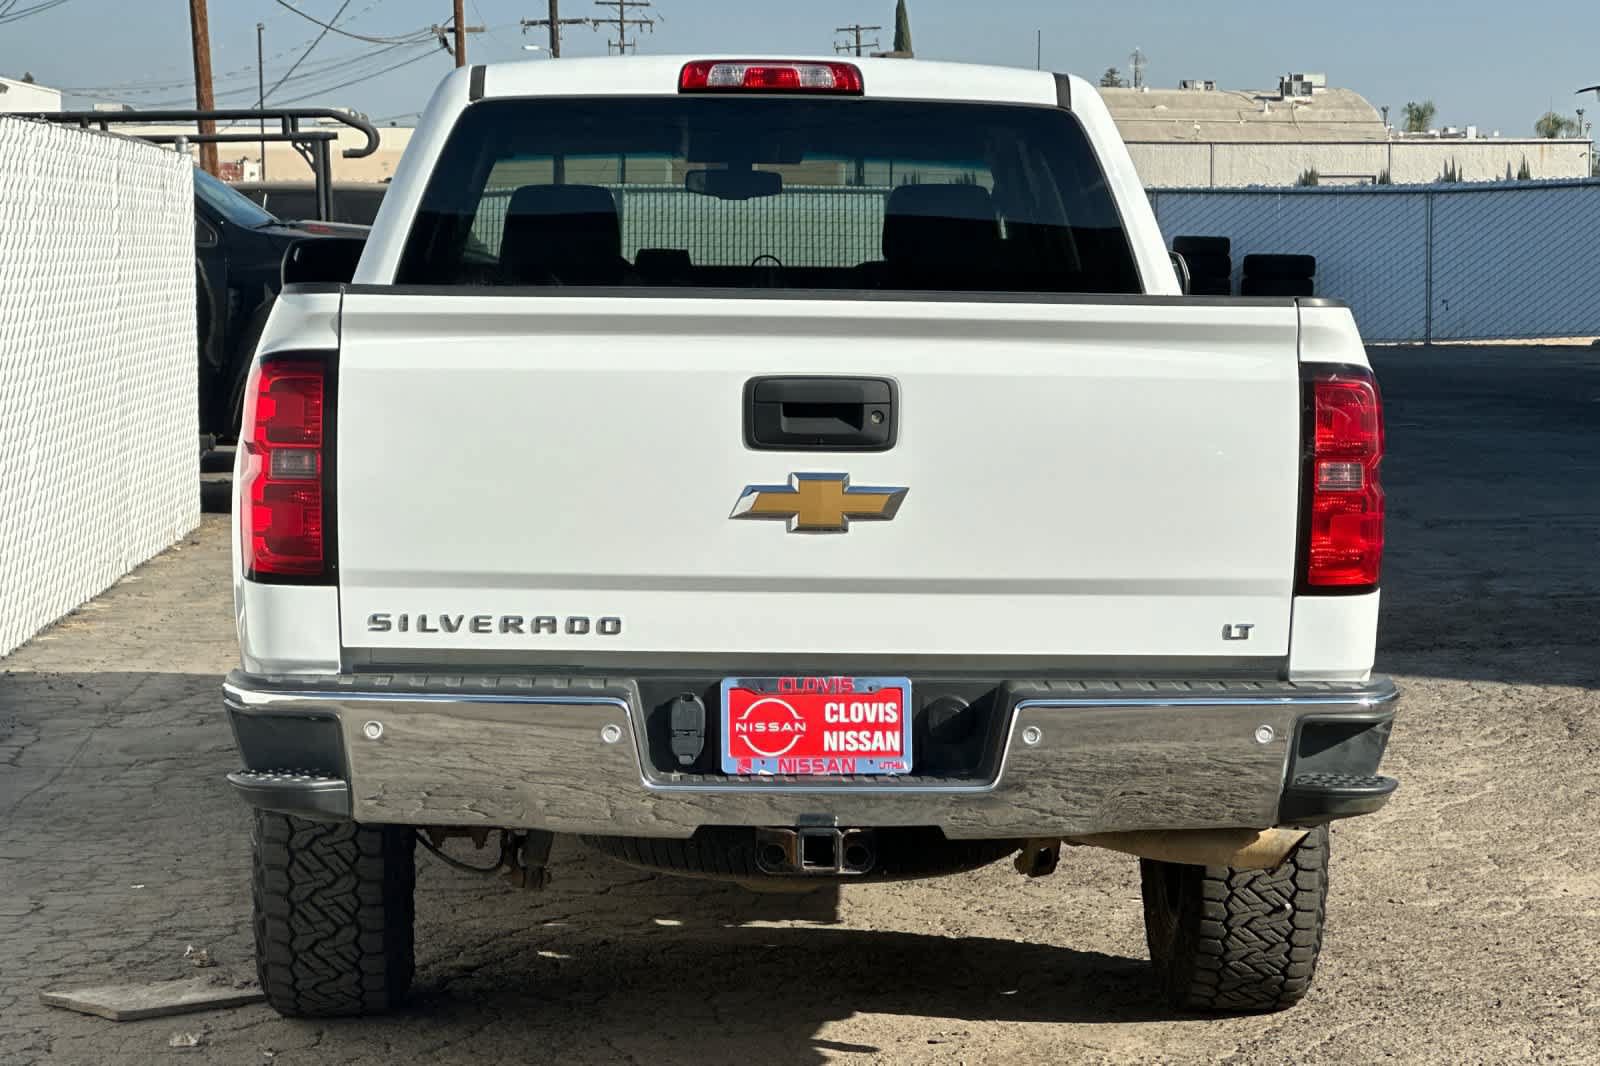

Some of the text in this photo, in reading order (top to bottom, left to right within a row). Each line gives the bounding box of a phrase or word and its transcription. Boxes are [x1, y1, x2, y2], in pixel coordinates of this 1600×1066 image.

[367, 613, 622, 636] SILVERADO
[1222, 623, 1255, 640] LT
[777, 676, 855, 694] CLOVIS
[824, 702, 898, 723] CLOVIS
[735, 722, 807, 732] NISSAN
[823, 730, 900, 752] NISSAN
[777, 758, 856, 773] NISSAN
